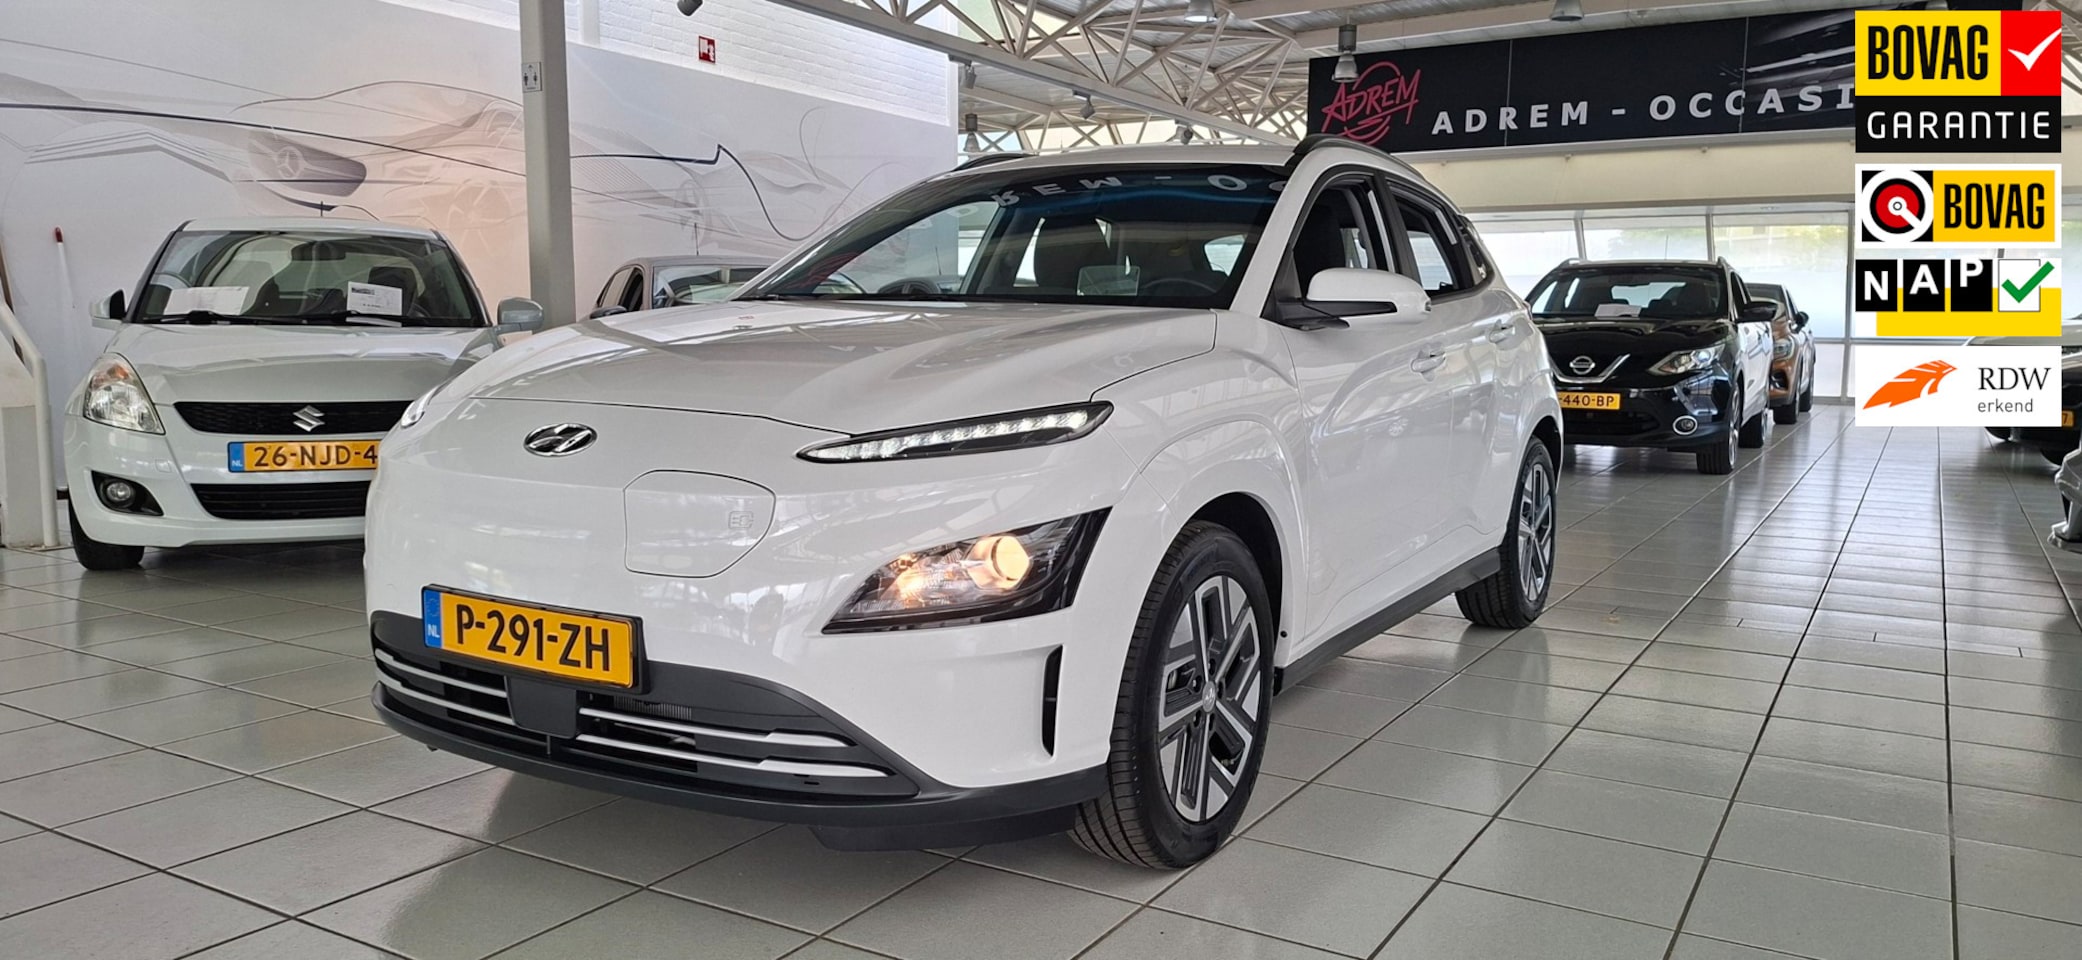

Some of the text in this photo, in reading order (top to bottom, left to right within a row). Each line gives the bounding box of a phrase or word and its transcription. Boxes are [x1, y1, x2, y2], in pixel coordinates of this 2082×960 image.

[1321, 69, 1422, 133] ADREM
[1431, 101, 1589, 135] ADREM
[1649, 84, 1855, 121] OCCASI
[231, 459, 243, 467] NL
[427, 624, 440, 638] NL
[456, 603, 610, 672] P-291-ZH
